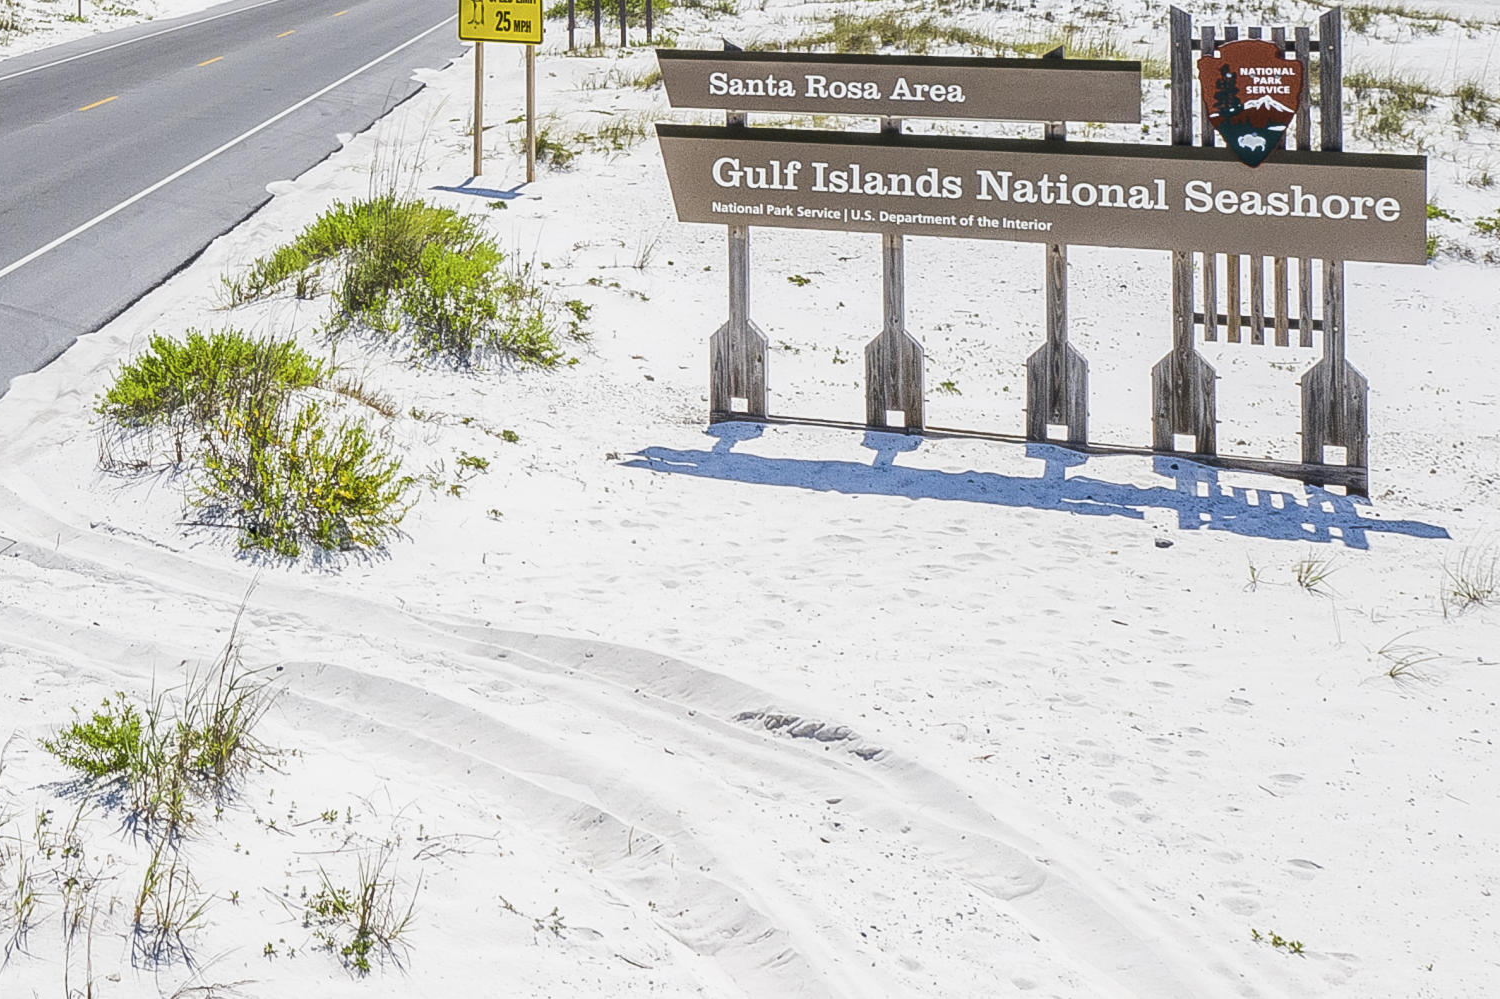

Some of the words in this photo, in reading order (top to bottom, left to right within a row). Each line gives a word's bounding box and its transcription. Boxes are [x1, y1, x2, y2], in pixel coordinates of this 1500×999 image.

[495, 11, 511, 32] 25
[513, 20, 531, 33] MPH
[1240, 67, 1296, 75] NATIONAL
[1253, 77, 1282, 85] PARK
[709, 72, 797, 97] Santa
[804, 75, 882, 100] Rosa
[889, 77, 966, 103] Area
[1246, 86, 1291, 94] SERVICE
[712, 157, 802, 191] Gulf
[811, 162, 963, 200] Islands
[976, 170, 1170, 211] National
[1184, 180, 1401, 222] Seashore
[711, 202, 764, 215] National
[766, 204, 792, 217] Park
[797, 206, 841, 219] Service
[851, 210, 876, 222] U.S.
[879, 211, 956, 227] Department
[959, 216, 975, 227] of
[976, 216, 998, 228] the
[1002, 217, 1053, 232] Interior
